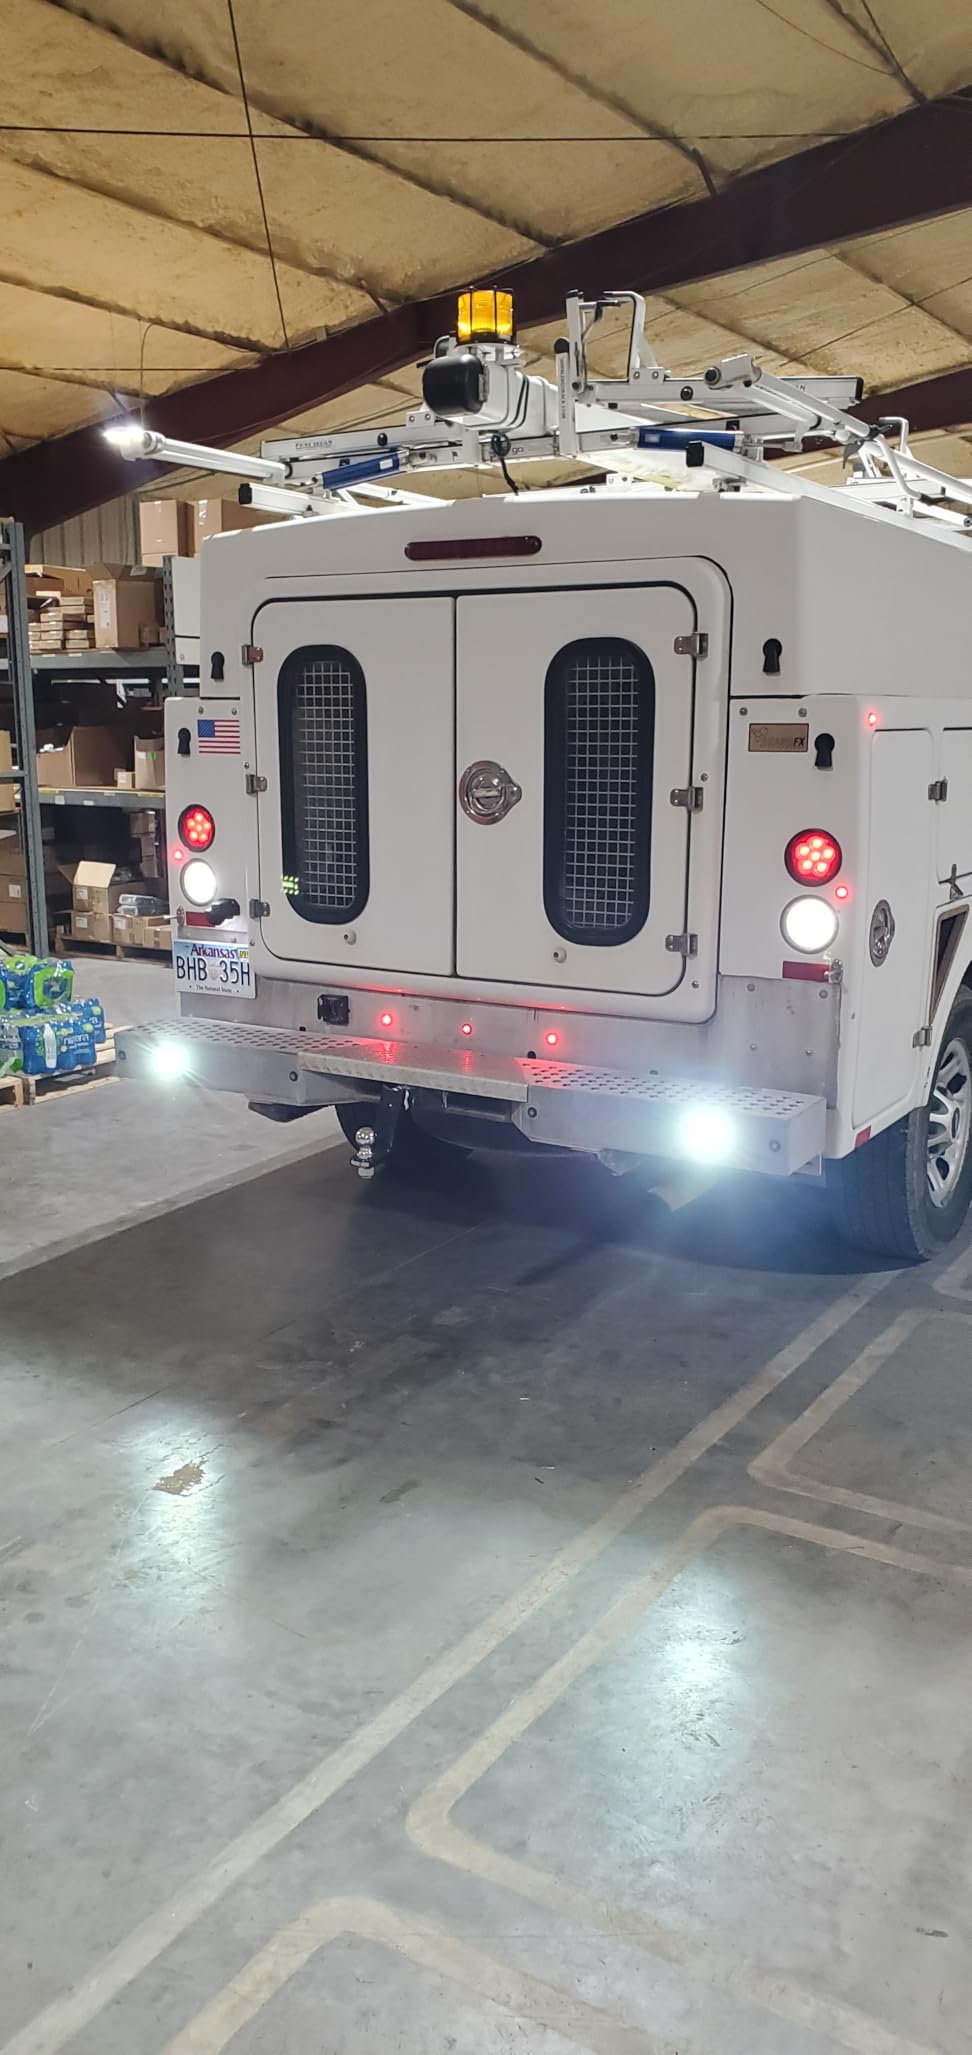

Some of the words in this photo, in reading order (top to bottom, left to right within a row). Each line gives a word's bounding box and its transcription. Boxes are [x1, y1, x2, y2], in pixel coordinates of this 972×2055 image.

[190, 943, 235, 959] Arkansas
[176, 955, 208, 981] BHB
[219, 960, 251, 987] 35H
